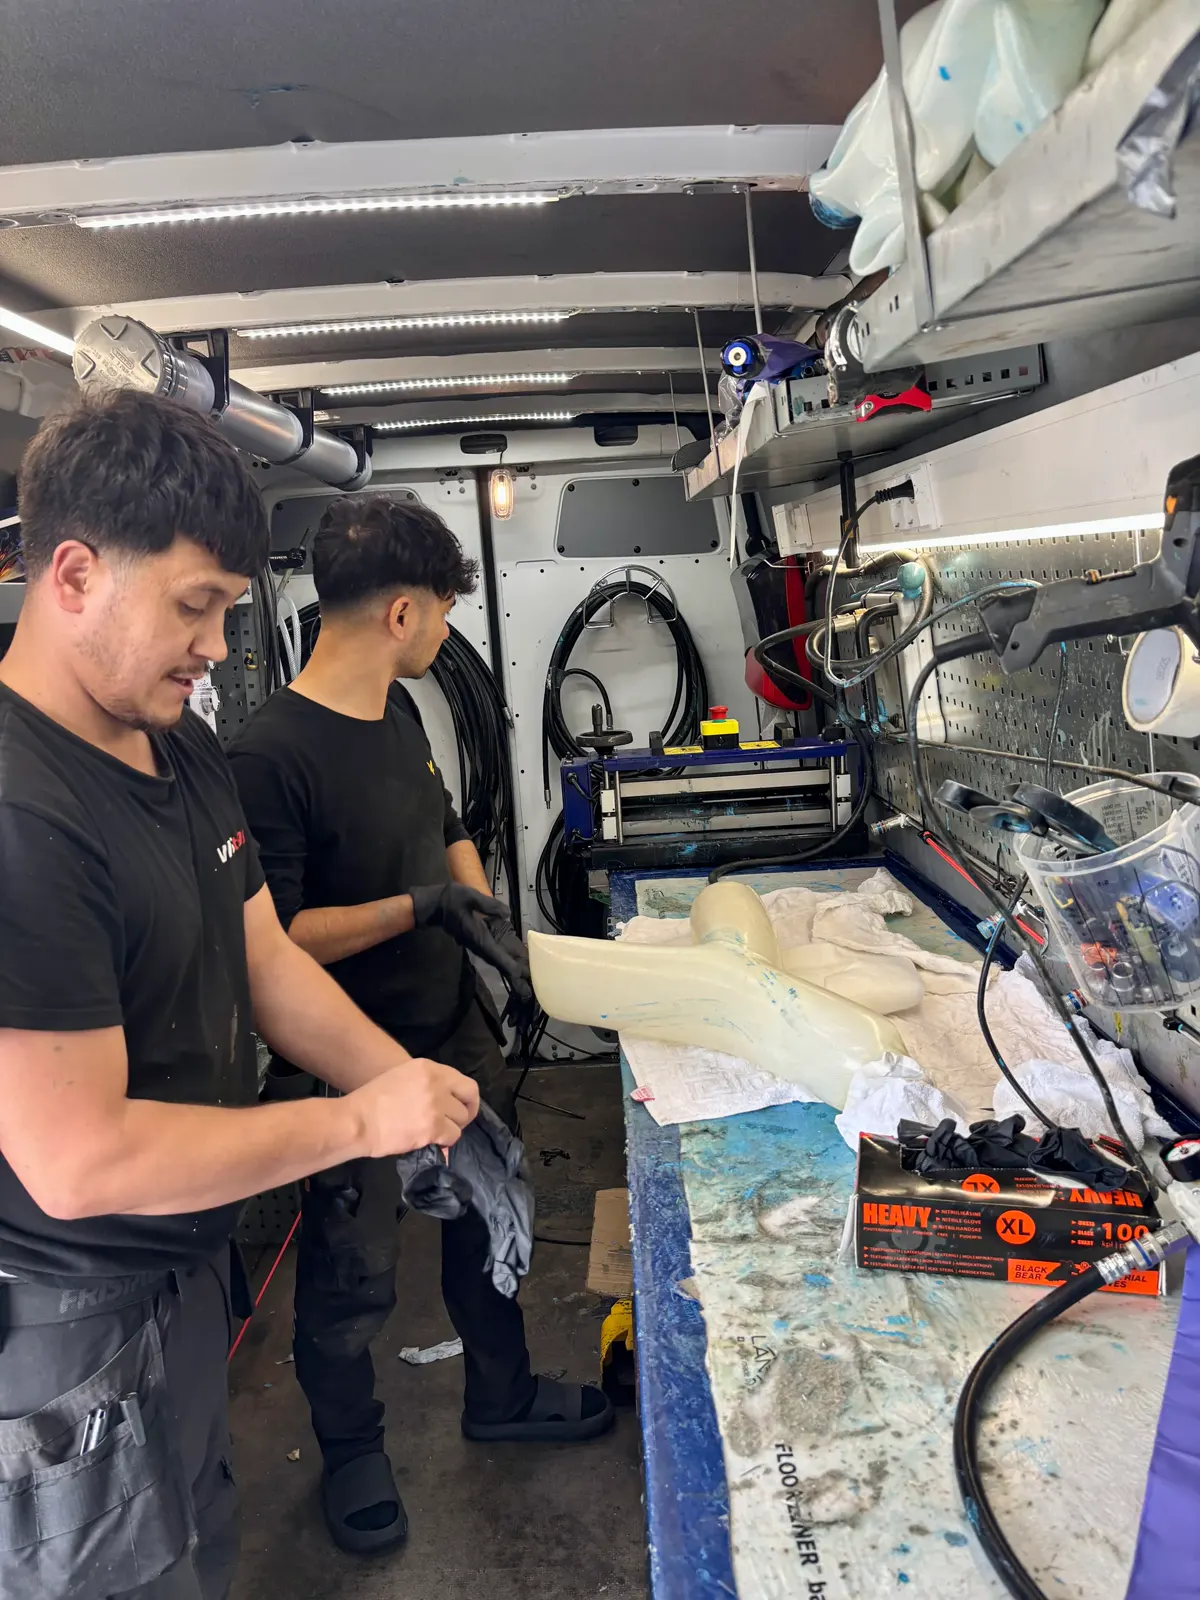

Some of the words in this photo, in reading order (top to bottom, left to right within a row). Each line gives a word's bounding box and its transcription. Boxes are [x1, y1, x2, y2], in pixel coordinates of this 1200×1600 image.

[863, 1203, 932, 1229] HEAVY
[1000, 1217, 1031, 1236] XL
[1101, 1222, 1149, 1242] 100
[1015, 1264, 1048, 1274] BLACK
[1015, 1271, 1042, 1281] BEAR
